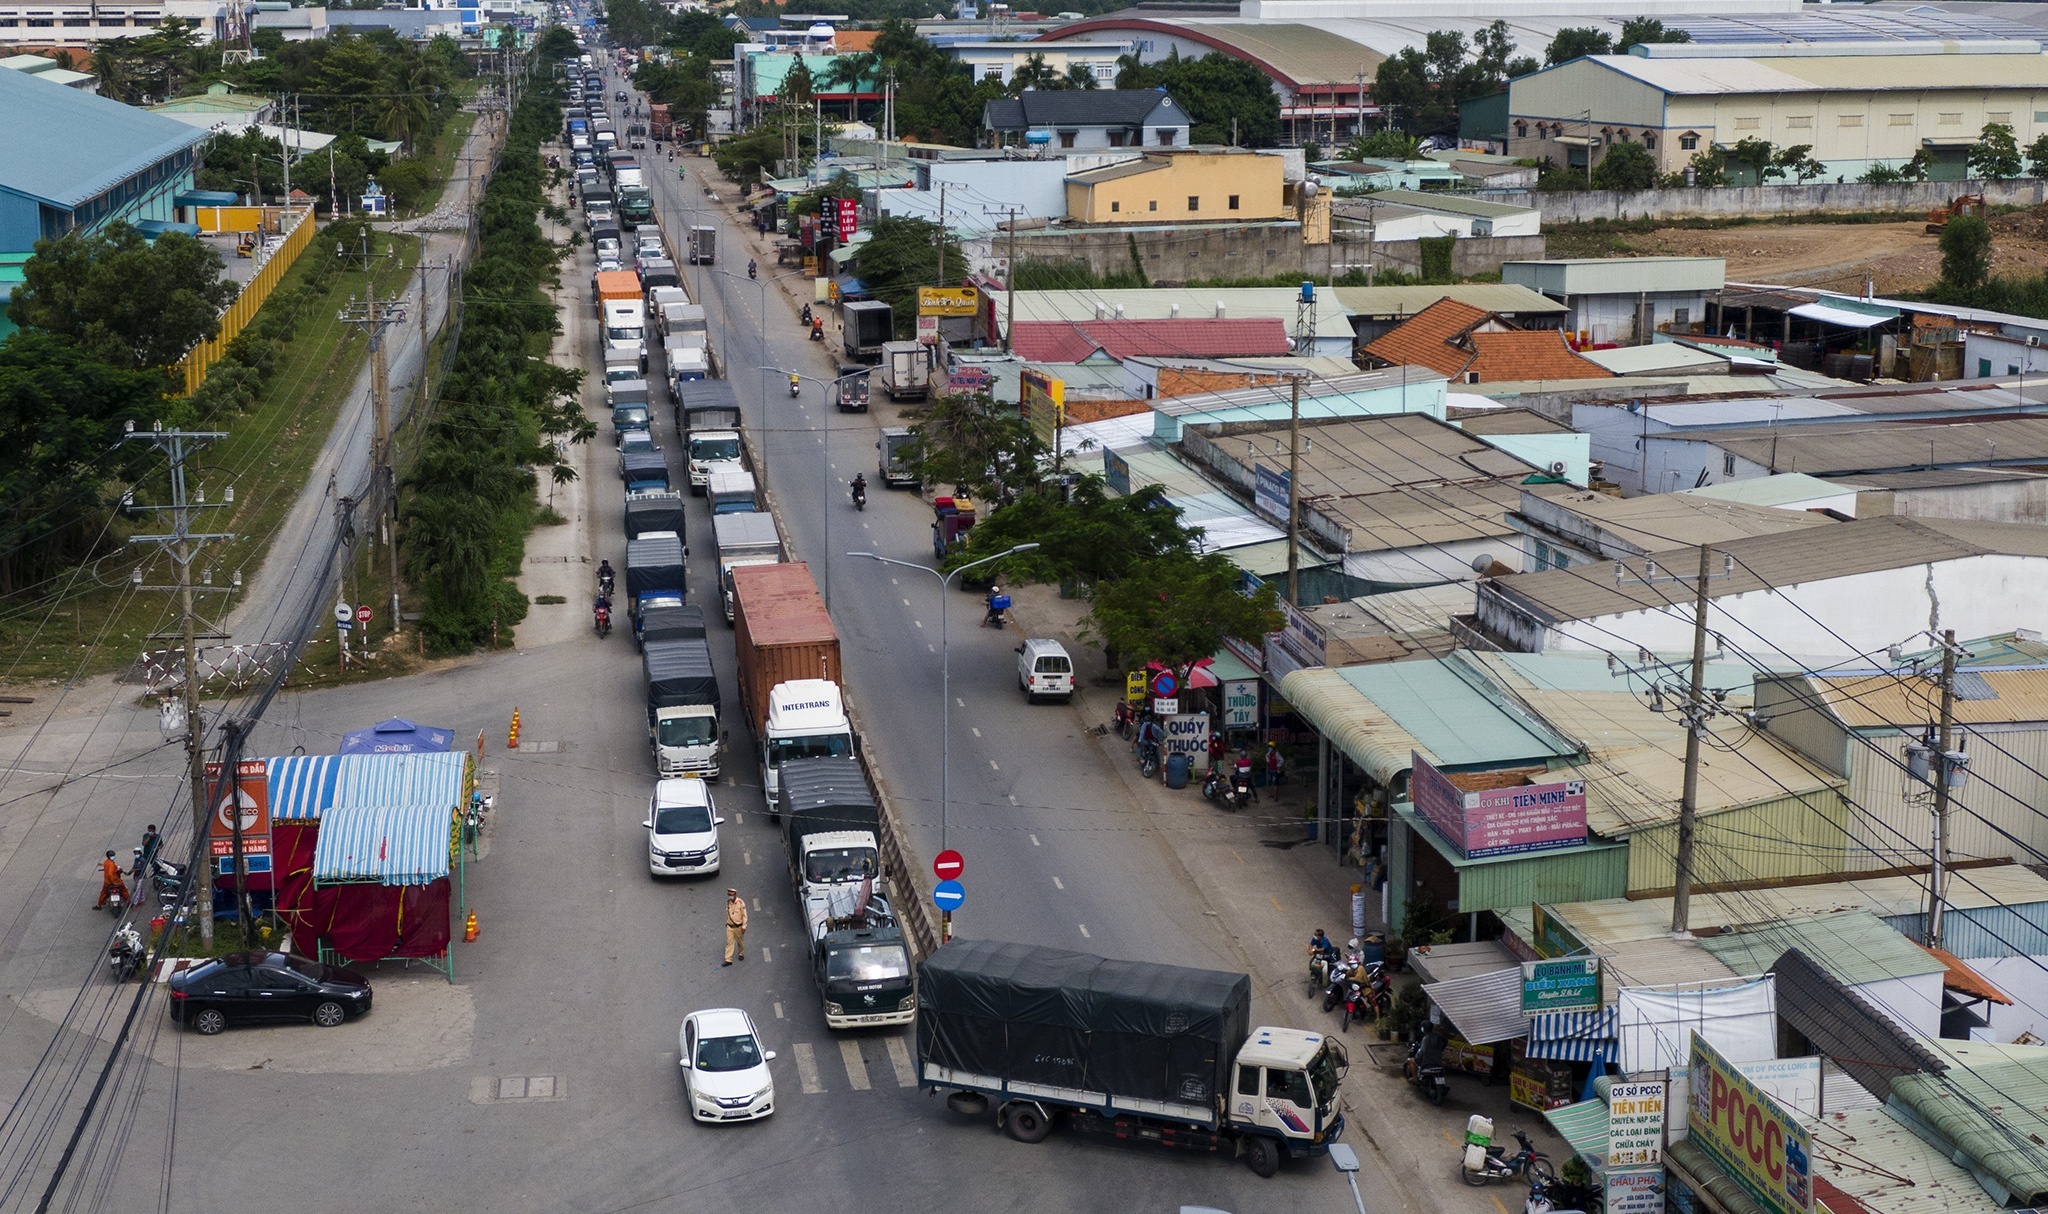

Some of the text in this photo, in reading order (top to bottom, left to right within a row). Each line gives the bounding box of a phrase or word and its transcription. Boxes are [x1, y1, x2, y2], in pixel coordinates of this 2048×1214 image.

[359, 610, 371, 618] STOP
[782, 700, 830, 712] INTERTRANS
[1227, 692, 1257, 707] THUỐC
[1233, 711, 1250, 722] TÂY
[1169, 717, 1205, 735] QUẦY
[375, 744, 411, 752] Mobil
[1167, 735, 1208, 752] THUỐC
[250, 762, 265, 774] DẦU
[1539, 791, 1565, 805] MINH
[248, 843, 267, 853] HÀNG
[1557, 976, 1596, 989] XANH
[1768, 1063, 1785, 1071] PCCC
[1787, 1062, 1807, 1070] LONG
[1626, 1083, 1637, 1096] SỞ
[1640, 1085, 1662, 1095] PCCC
[1612, 1095, 1662, 1115] TIÊN TIẾN
[1649, 1114, 1661, 1124] SẠC
[1711, 1068, 1783, 1183] PCCC
[1766, 1099, 1781, 1119] PCCC
[1781, 1113, 1797, 1134] LONG
[1797, 1126, 1807, 1141] AN
[1610, 1125, 1661, 1138] CÁC LOẠI BÌNH
[1637, 1176, 1657, 1185] PHA
